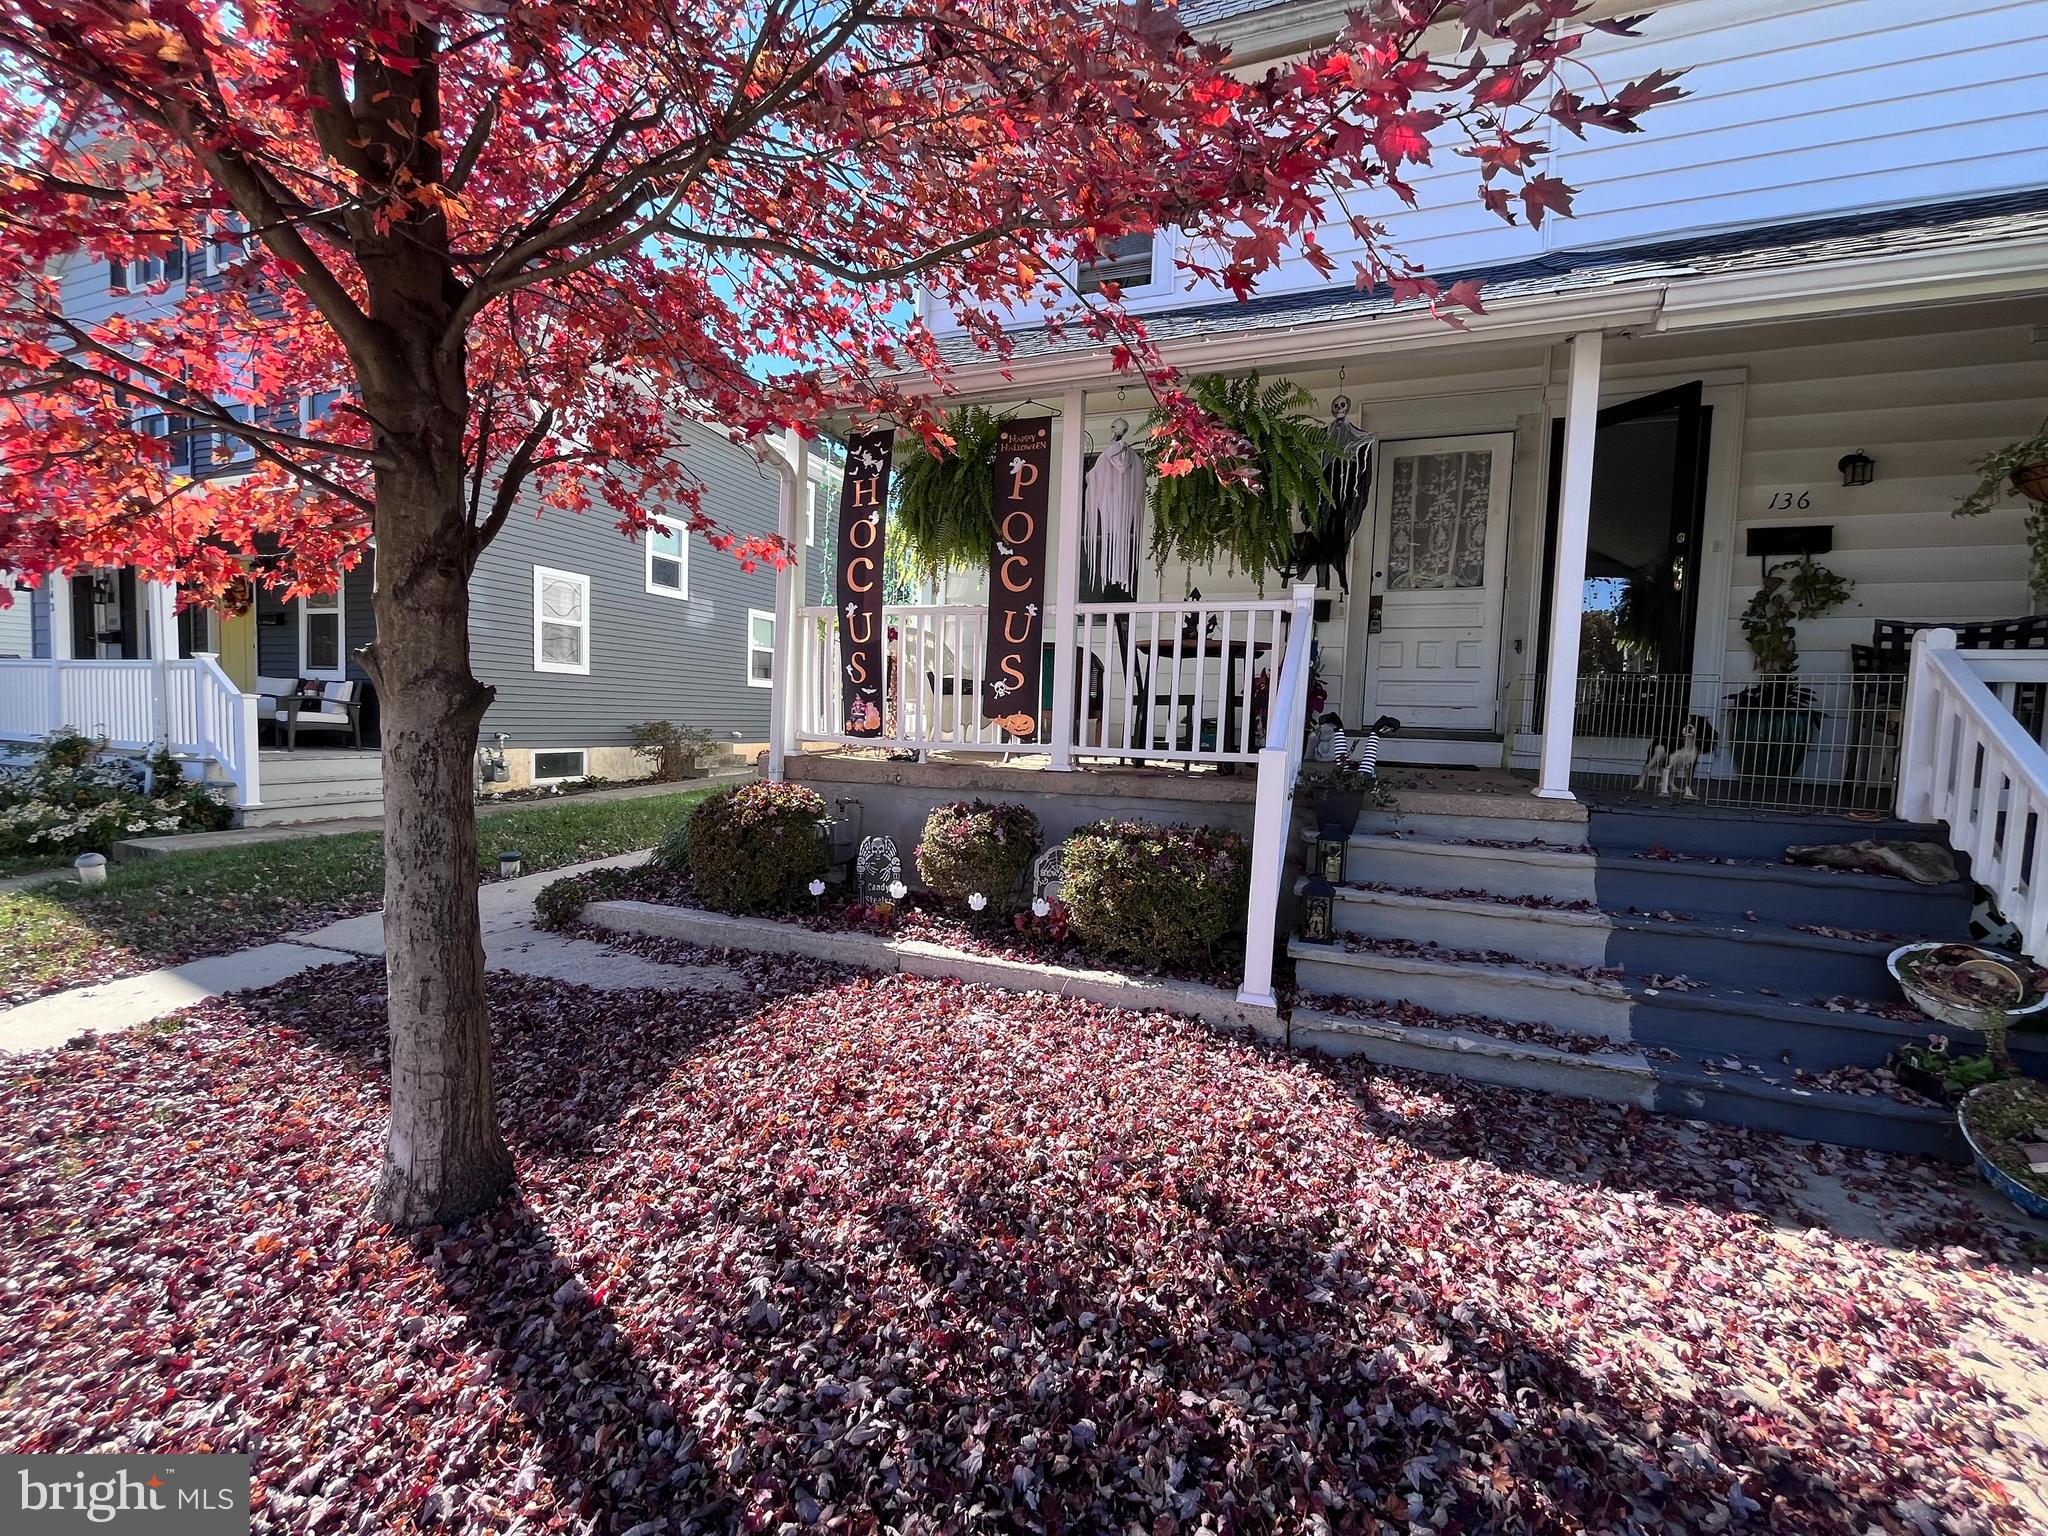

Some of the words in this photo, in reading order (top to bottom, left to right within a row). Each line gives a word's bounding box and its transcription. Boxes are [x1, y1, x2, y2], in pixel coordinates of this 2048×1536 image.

[1009, 434, 1037, 443] HAPPY
[1000, 441, 1047, 452] HALLOWEEN
[1768, 491, 1811, 510] 136
[846, 475, 880, 684] HOCUS
[1000, 462, 1039, 691] POCUS
[1040, 870, 1065, 878] BEWA
[867, 882, 891, 894] Candy
